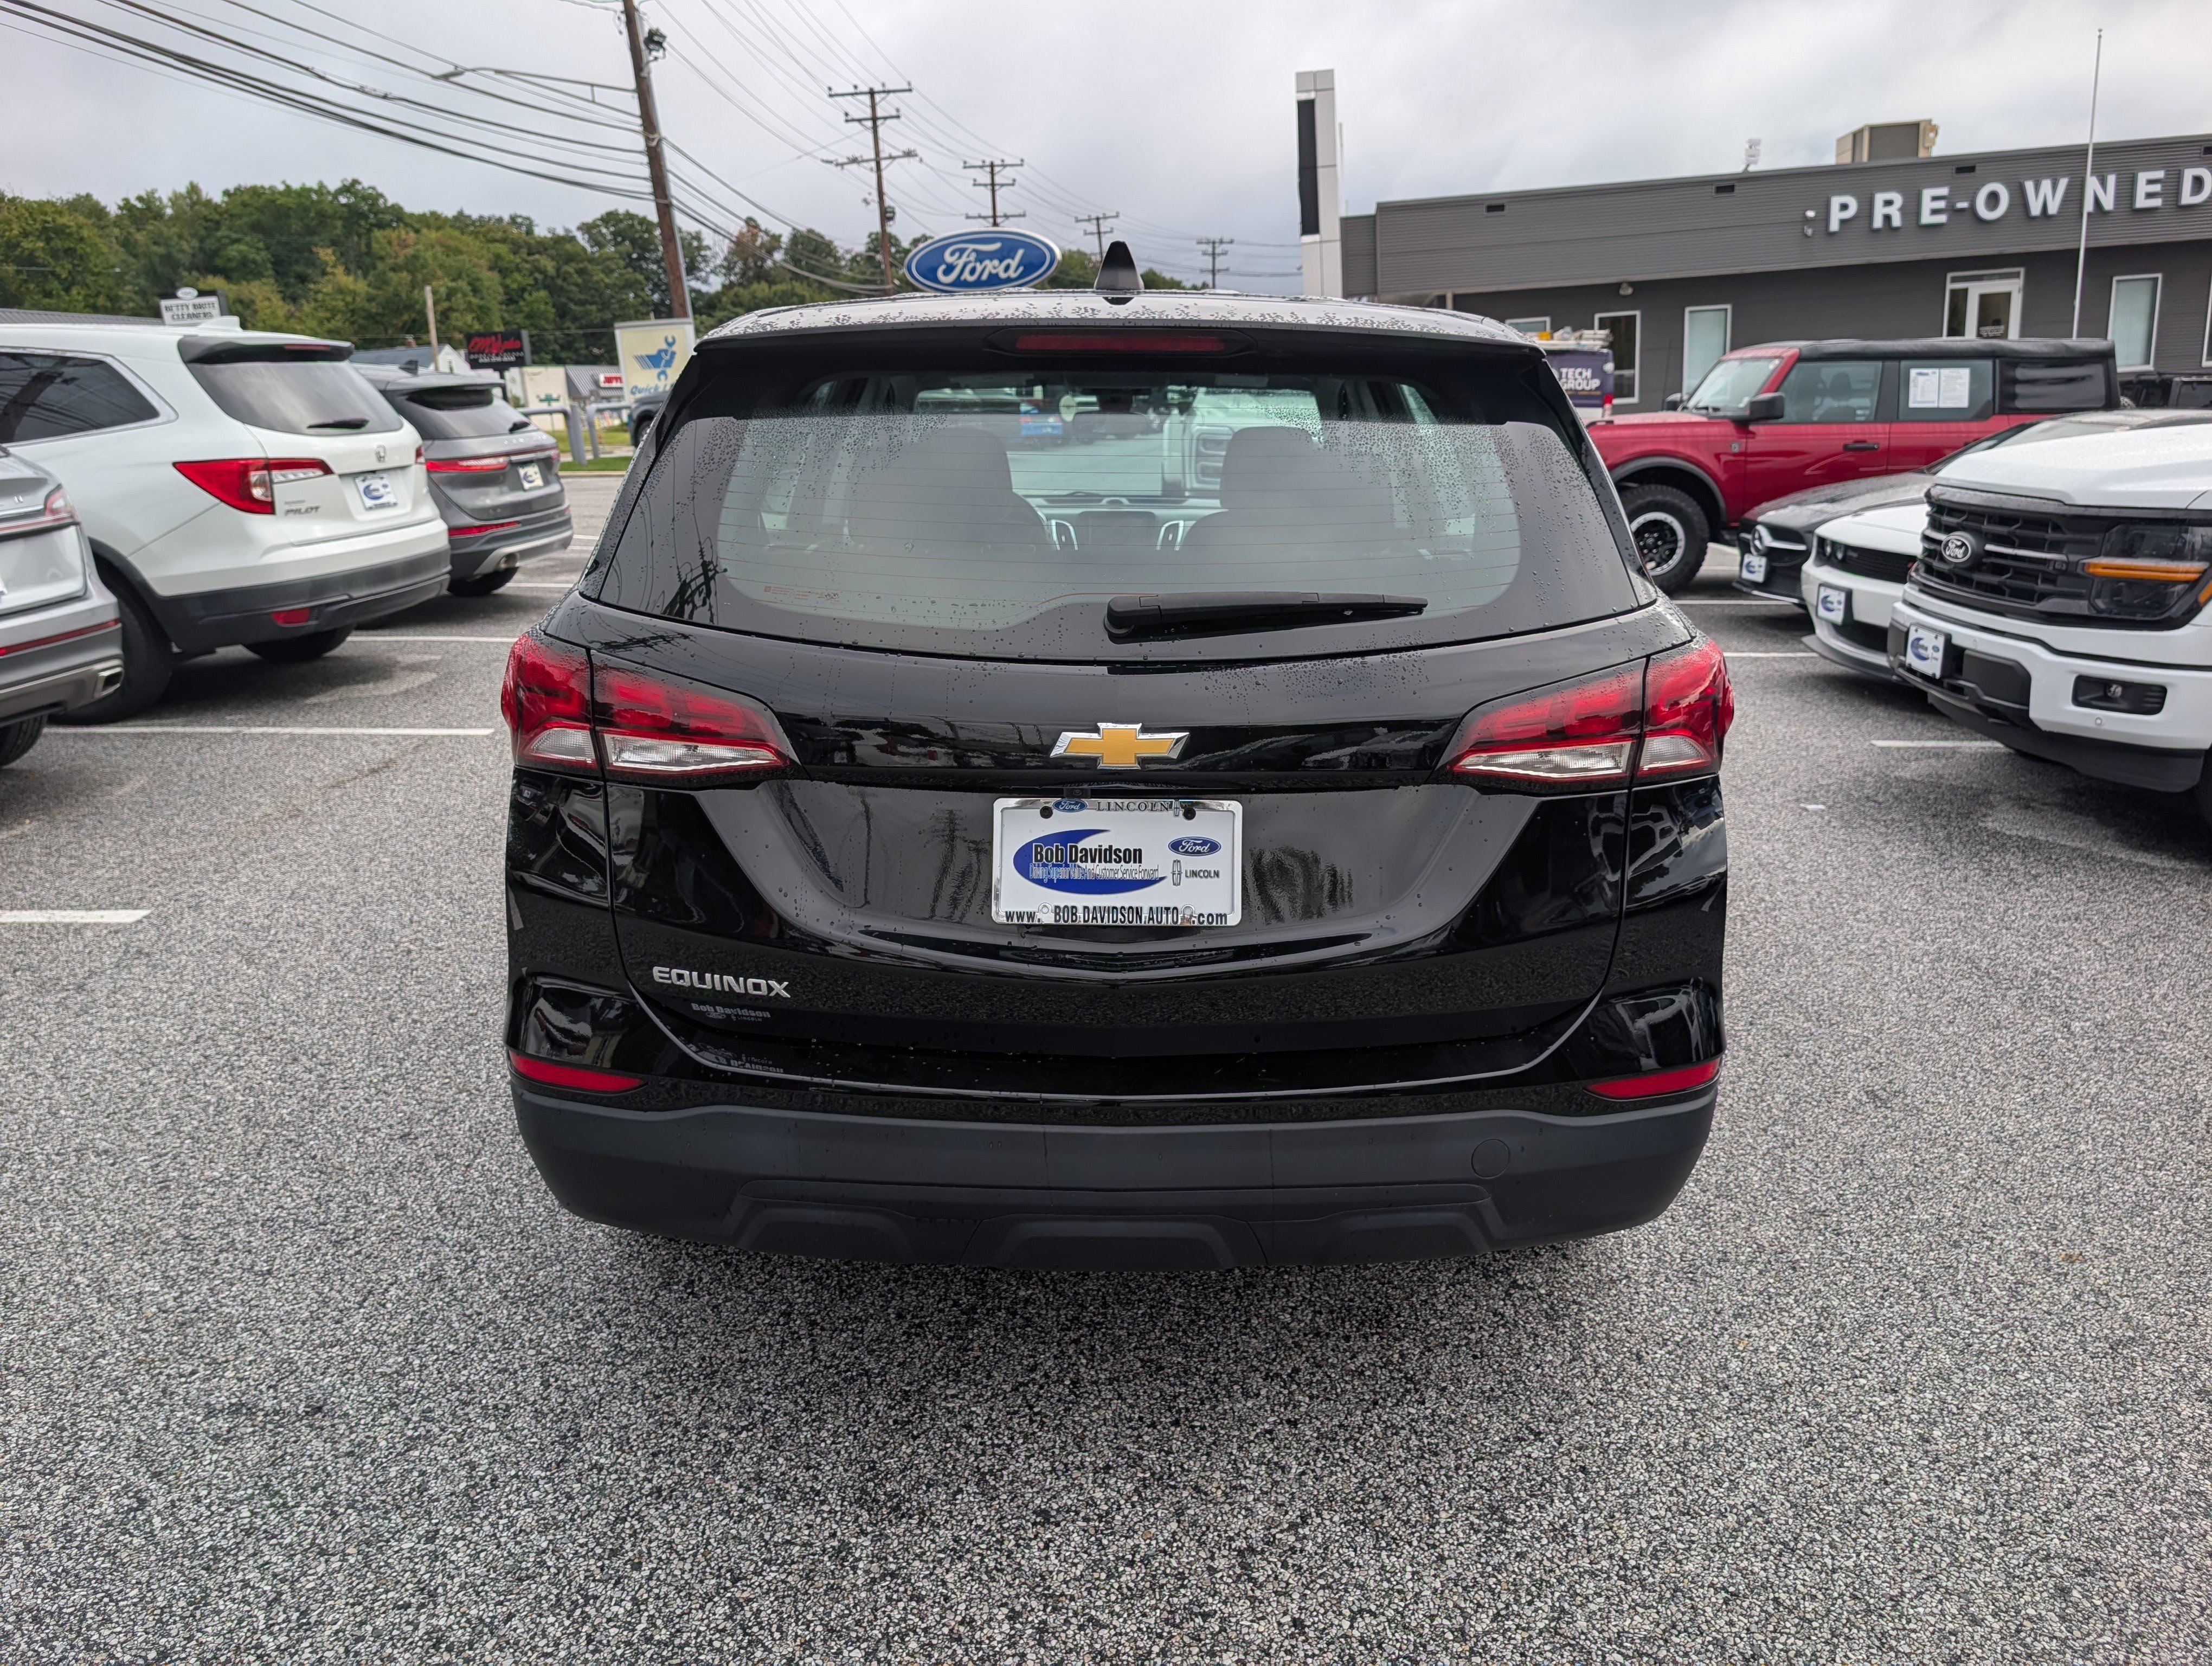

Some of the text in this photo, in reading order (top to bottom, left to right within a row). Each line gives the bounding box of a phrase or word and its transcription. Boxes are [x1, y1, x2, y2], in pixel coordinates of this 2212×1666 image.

[1828, 166, 2212, 233] PRE-OWNED
[936, 241, 1026, 284] Ford
[171, 311, 214, 321] CLEANERS
[1560, 368, 1592, 379] TECH
[630, 384, 659, 395] Quick
[1560, 379, 1601, 390] GROUP
[285, 505, 320, 515] PILOT
[1059, 800, 1081, 810] Ford
[1096, 801, 1170, 812] LINCOLN
[1178, 839, 1211, 854] Ford
[1033, 843, 1143, 864] Bob Davidson
[1029, 863, 1159, 883] Driving Superior Value And Customer Service Forward
[1184, 869, 1220, 879] LINCOLN
[653, 966, 791, 998] EQUINOX
[691, 1003, 715, 1013] Bob
[715, 1005, 771, 1018] Davidson
